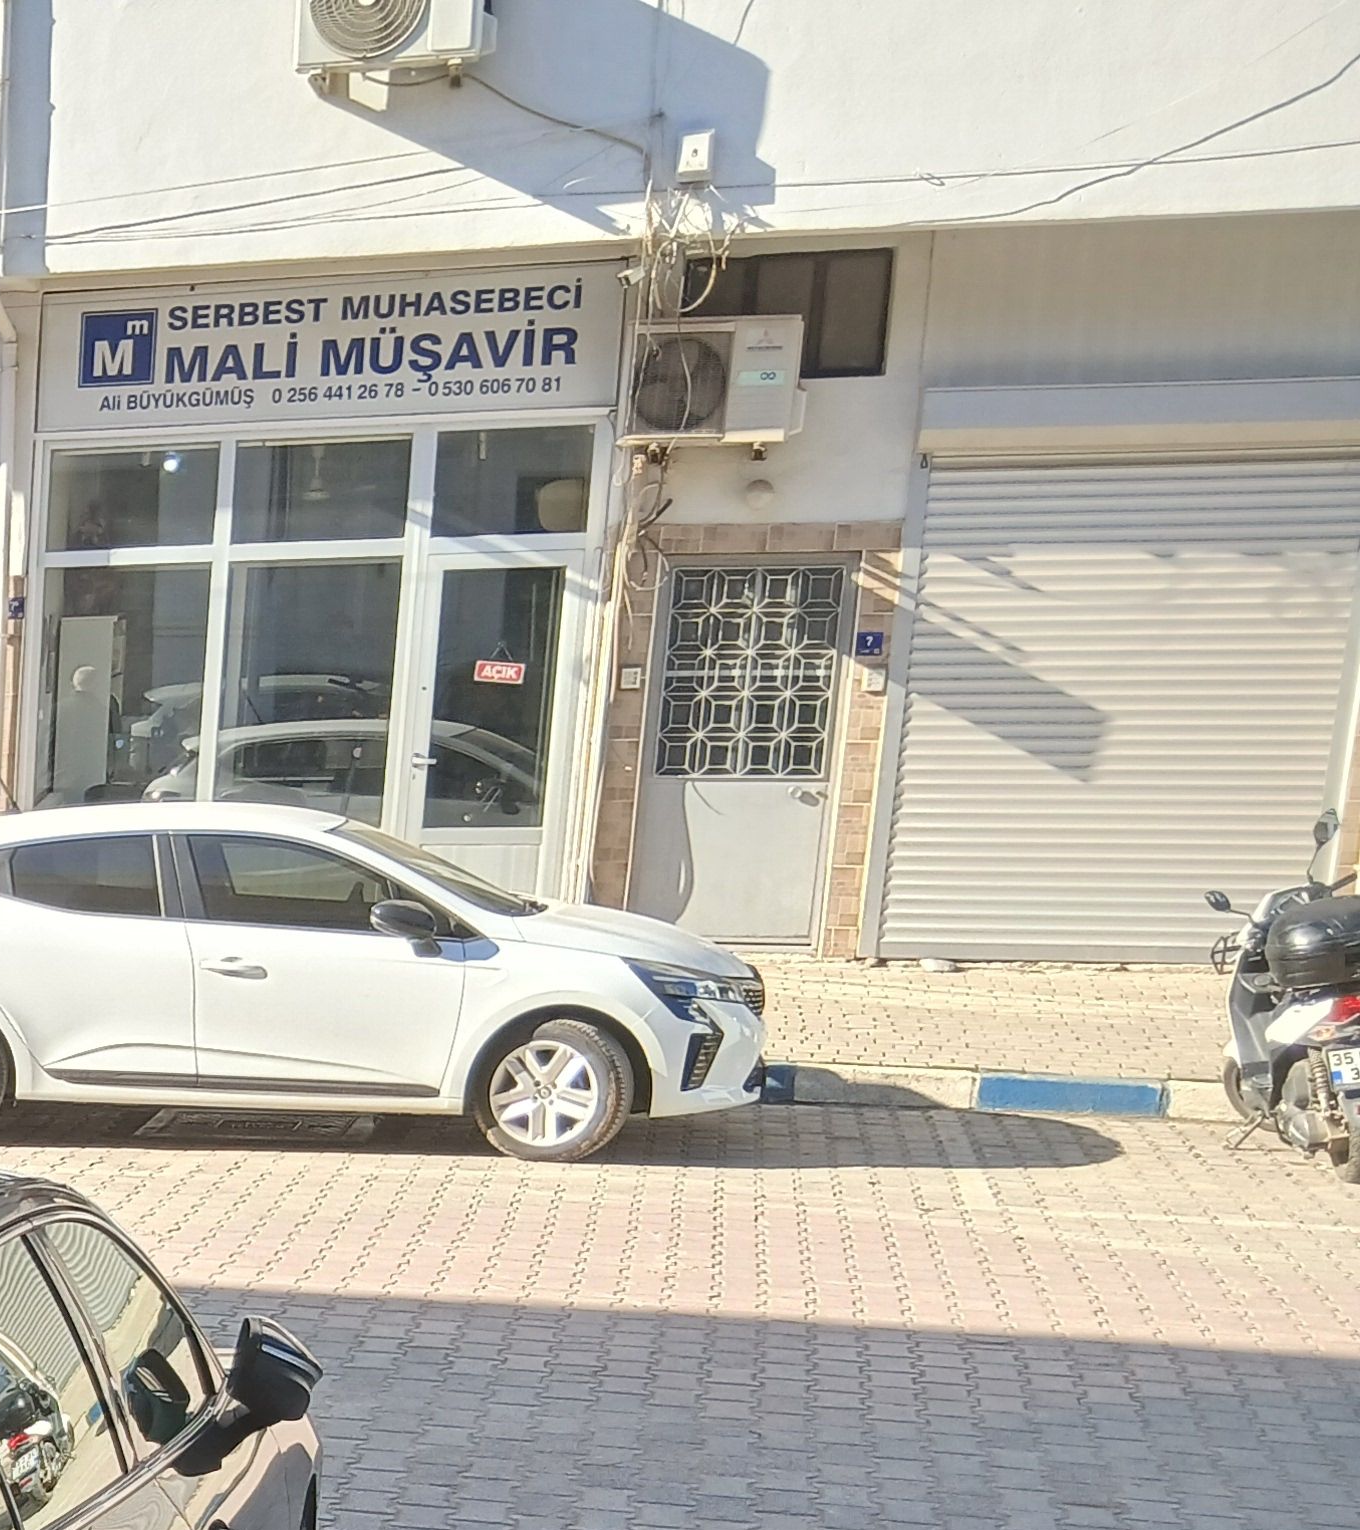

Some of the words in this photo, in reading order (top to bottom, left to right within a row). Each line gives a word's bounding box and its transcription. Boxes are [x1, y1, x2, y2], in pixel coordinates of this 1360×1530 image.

[167, 297, 328, 331] SERBEST
[340, 277, 582, 321] MUHASEBECİ
[164, 332, 298, 385] MALİ
[319, 318, 579, 383] MÜŞAVİR
[99, 395, 121, 412] Ali
[126, 387, 255, 410] BÜYÜKGÜMÜŞ
[271, 388, 282, 404] 0
[286, 386, 319, 404] 256
[322, 384, 353, 402] 441
[357, 383, 379, 400] 26
[384, 382, 405, 399] 78
[442, 379, 474, 397] 530
[480, 378, 512, 396] 606
[515, 377, 537, 393] 70
[541, 376, 562, 393] 81
[866, 636, 874, 647] 7
[480, 664, 519, 681] AÇIK
[1332, 1052, 1353, 1066] 35
